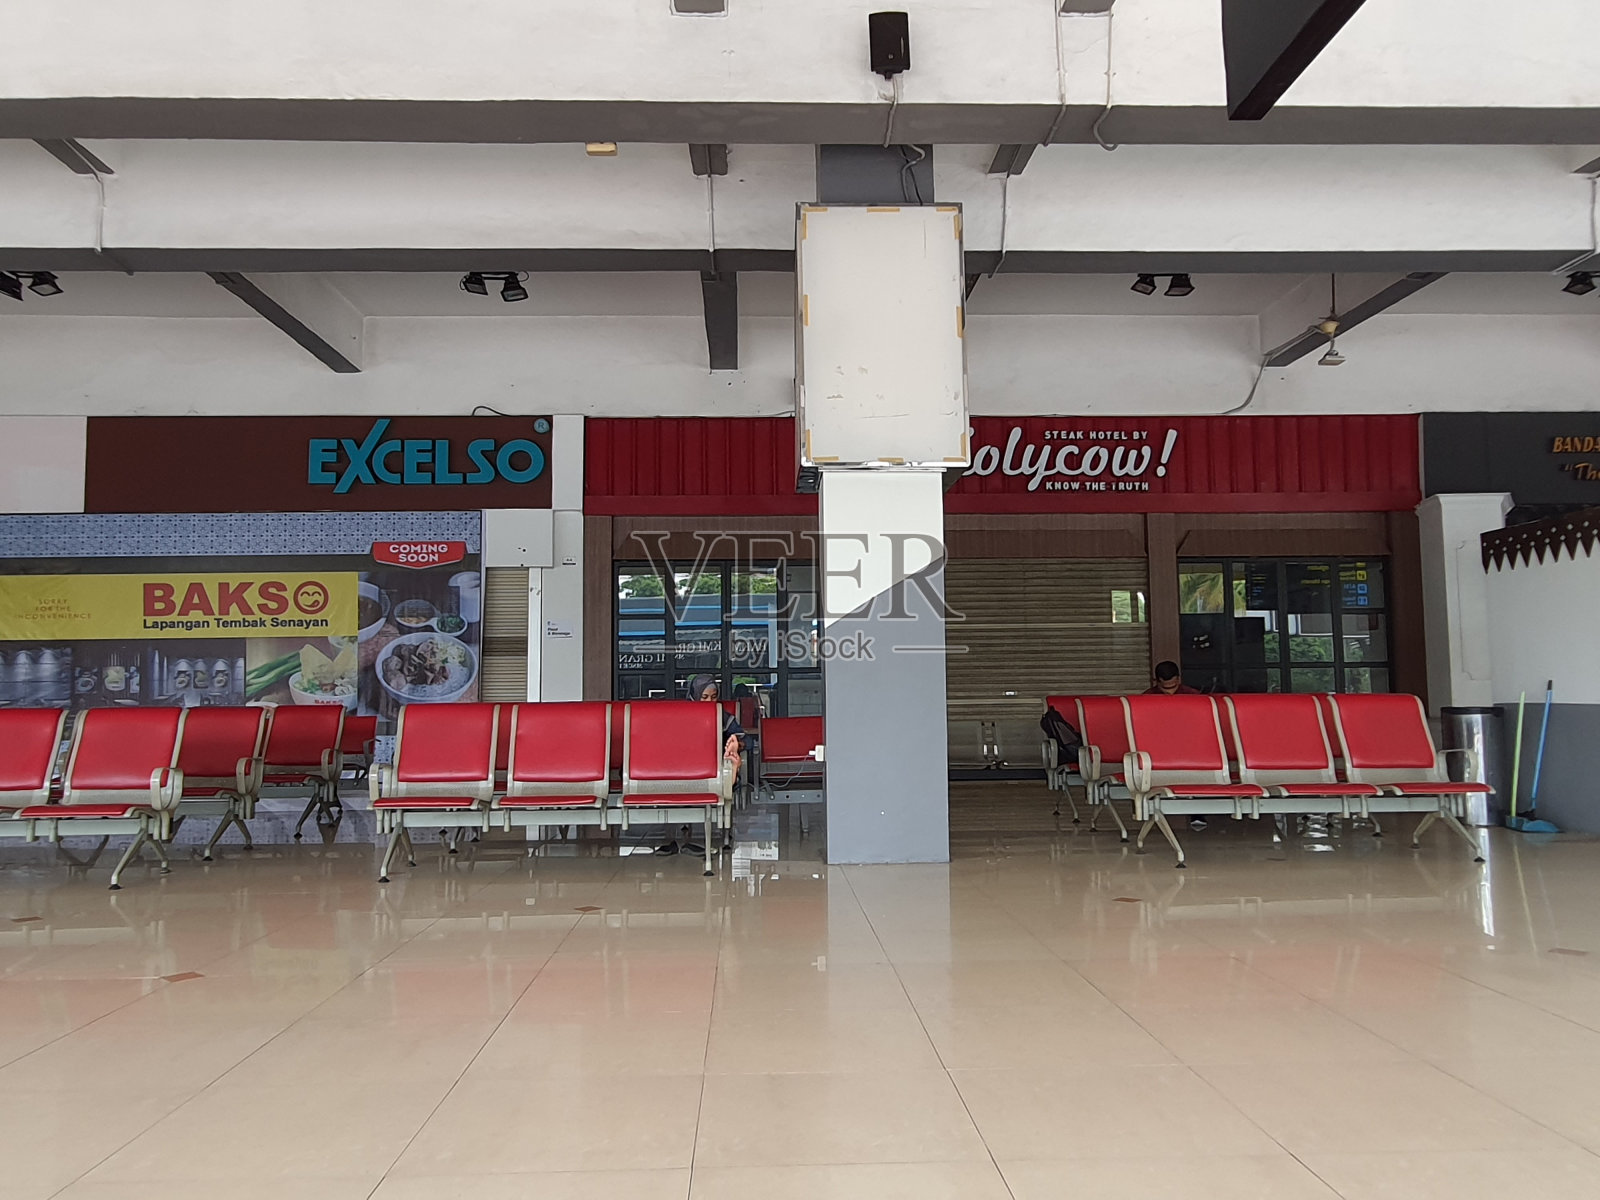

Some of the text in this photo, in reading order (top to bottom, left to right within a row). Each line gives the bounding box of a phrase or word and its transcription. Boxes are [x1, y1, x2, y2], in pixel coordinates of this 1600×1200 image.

[1045, 431, 1148, 440] STEAK HOTEL BY
[307, 418, 545, 494] EXCELSO
[961, 427, 1178, 492] olycow!
[1045, 482, 1080, 490] KNOW
[1085, 482, 1106, 490] THE
[389, 544, 448, 553] COMING
[398, 553, 439, 562] SOON
[143, 581, 329, 616] BAKSO
[143, 617, 329, 631] Lapangan Tembak Senayan
